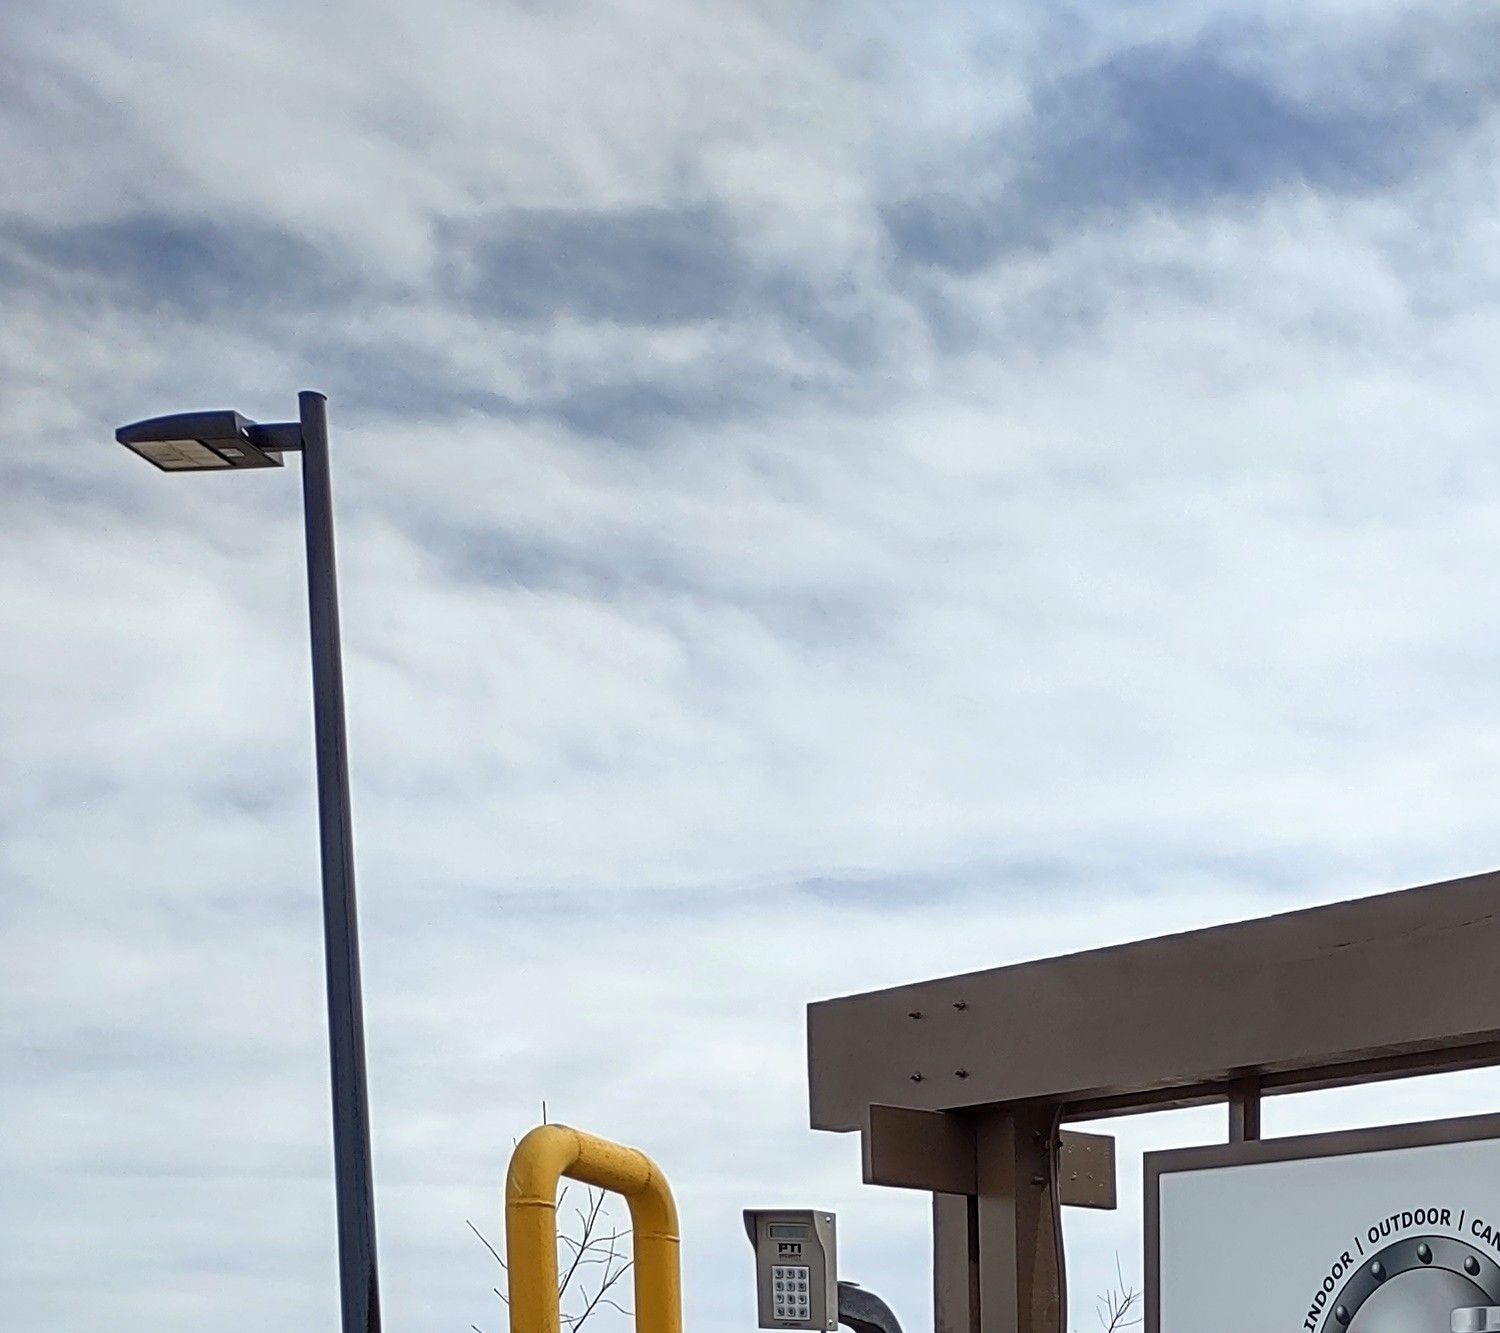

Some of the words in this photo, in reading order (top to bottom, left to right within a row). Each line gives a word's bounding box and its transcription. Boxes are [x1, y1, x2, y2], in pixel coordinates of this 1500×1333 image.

[778, 1243, 801, 1253] PTI
[1303, 1251, 1354, 1333] INDOOR
[1367, 1207, 1451, 1244] OUTDOOR
